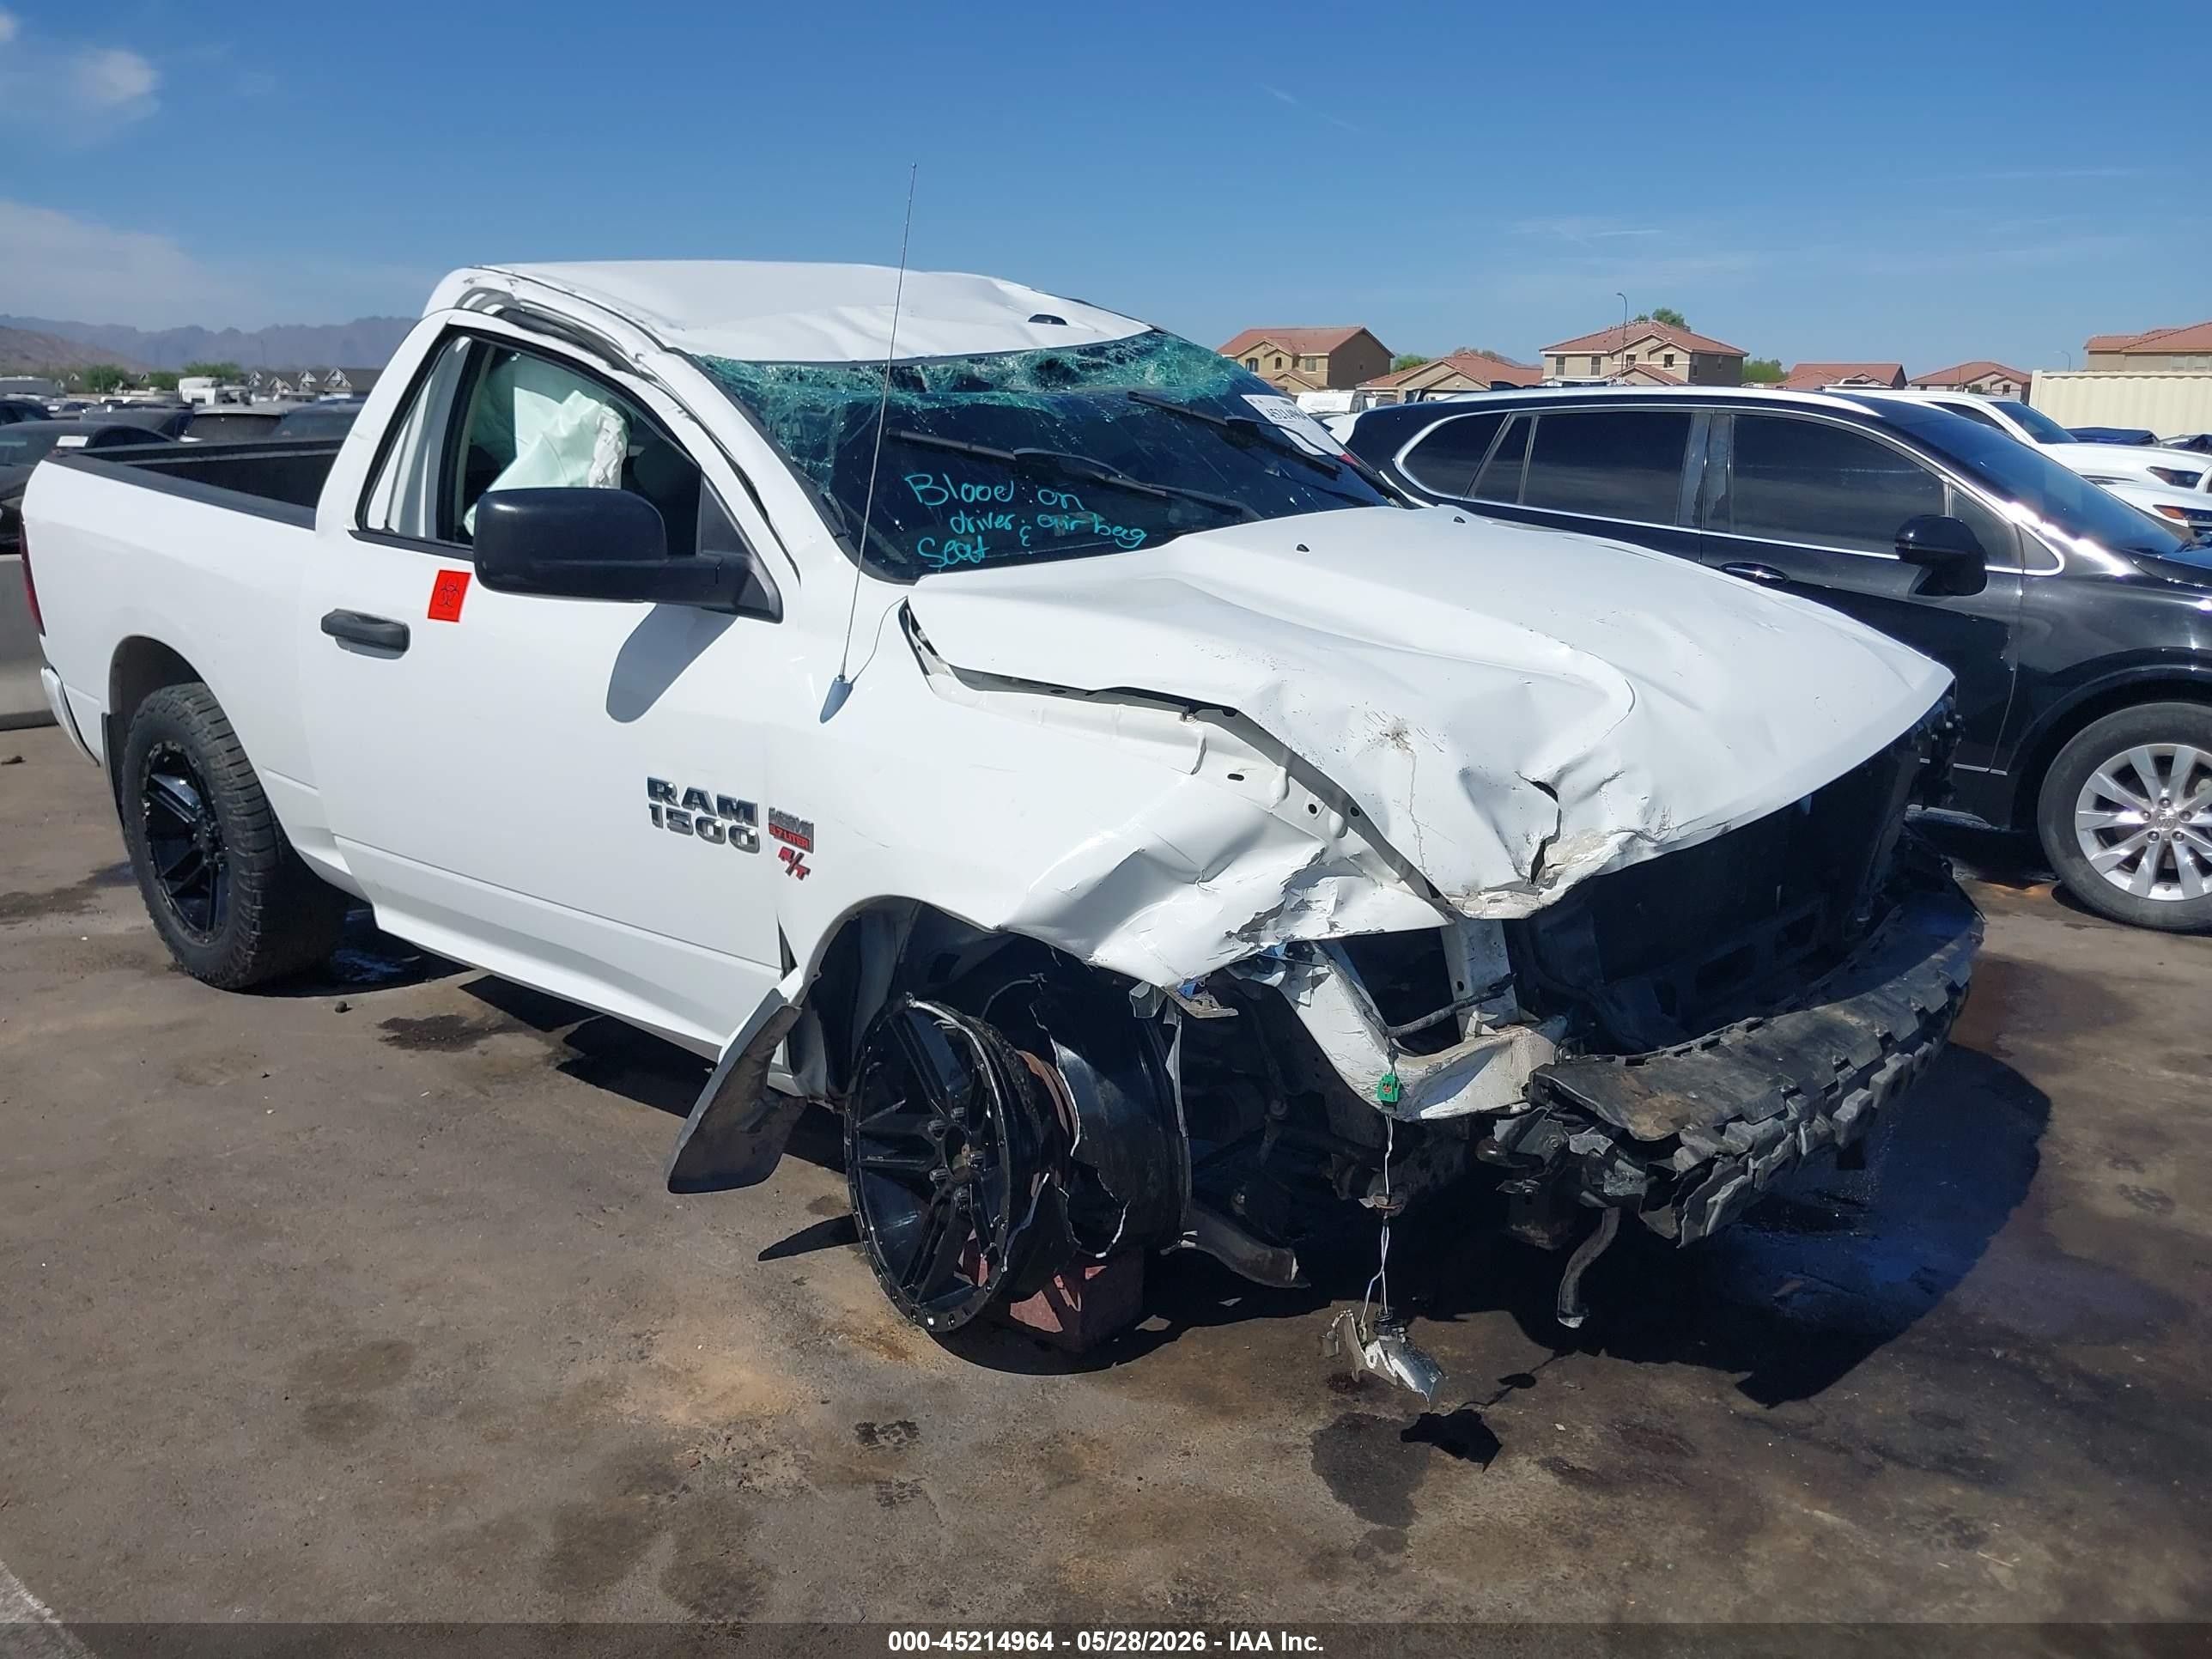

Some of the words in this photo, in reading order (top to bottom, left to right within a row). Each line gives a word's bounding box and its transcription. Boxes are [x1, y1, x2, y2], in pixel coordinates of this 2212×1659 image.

[904, 472, 1015, 506] Blood
[1037, 489, 1085, 510] on
[950, 510, 1016, 534] driver
[1036, 514, 1086, 531] air
[918, 535, 990, 568] Seat
[647, 776, 759, 827] RAM
[648, 803, 761, 854] 1500
[784, 829, 809, 849] LITER
[778, 846, 811, 880] R/T
